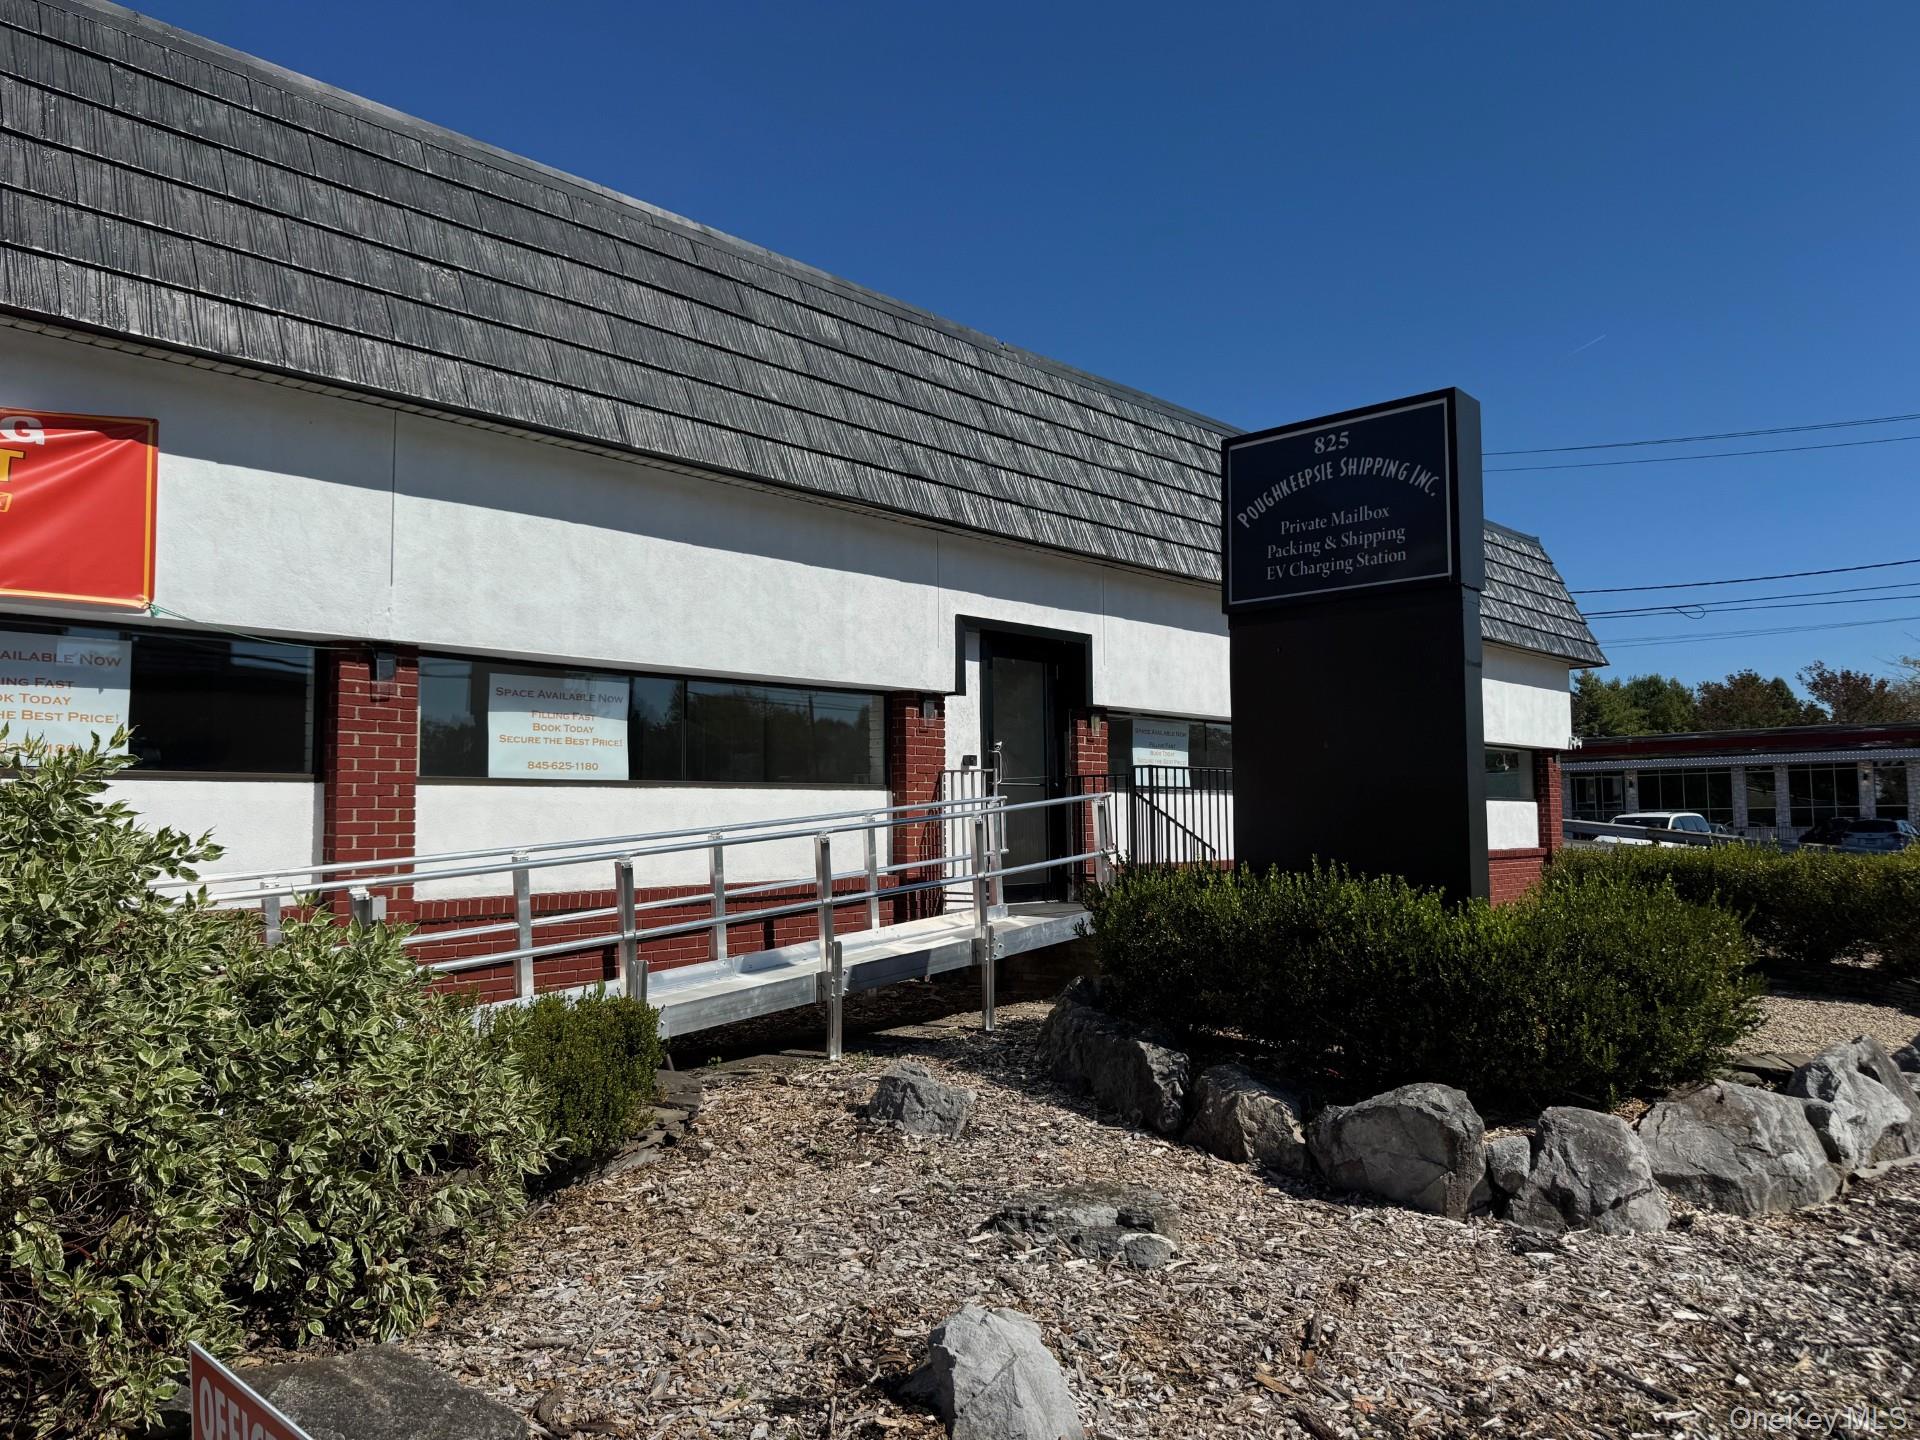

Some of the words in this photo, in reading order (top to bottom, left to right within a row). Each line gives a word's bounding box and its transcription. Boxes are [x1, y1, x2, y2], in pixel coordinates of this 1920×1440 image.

[1314, 431, 1350, 454] 825
[1236, 461, 1334, 528] POUGHKEEPSIE
[1340, 456, 1411, 481] SHIPPING
[1409, 464, 1440, 497] INC.
[1280, 517, 1327, 535] Private
[1331, 505, 1390, 527] Mailbox
[1267, 540, 1321, 559] Packing
[1324, 535, 1337, 550] &
[1341, 526, 1406, 549] Shipping
[1266, 564, 1287, 581] EV
[1289, 556, 1353, 578] Charging
[1356, 550, 1407, 567] Station
[80, 654, 122, 667] NOW
[34, 677, 75, 688] FAST
[19, 693, 72, 705] TODAY
[495, 687, 535, 698] SPACE
[537, 689, 598, 702] AVAILABLE
[598, 694, 624, 704] NOW
[21, 709, 64, 722] BEST
[68, 711, 120, 724] PRICE!
[531, 710, 569, 720] FILLING
[572, 711, 596, 721] FAST
[532, 723, 561, 732] BOOK
[564, 723, 594, 733] TODAY
[499, 734, 541, 744] SECURE
[543, 737, 562, 745] THE
[565, 737, 590, 746] BEST
[592, 738, 623, 747] PRICE!
[527, 761, 599, 771] 845-625-1180
[200, 1377, 278, 1440] OFFI
